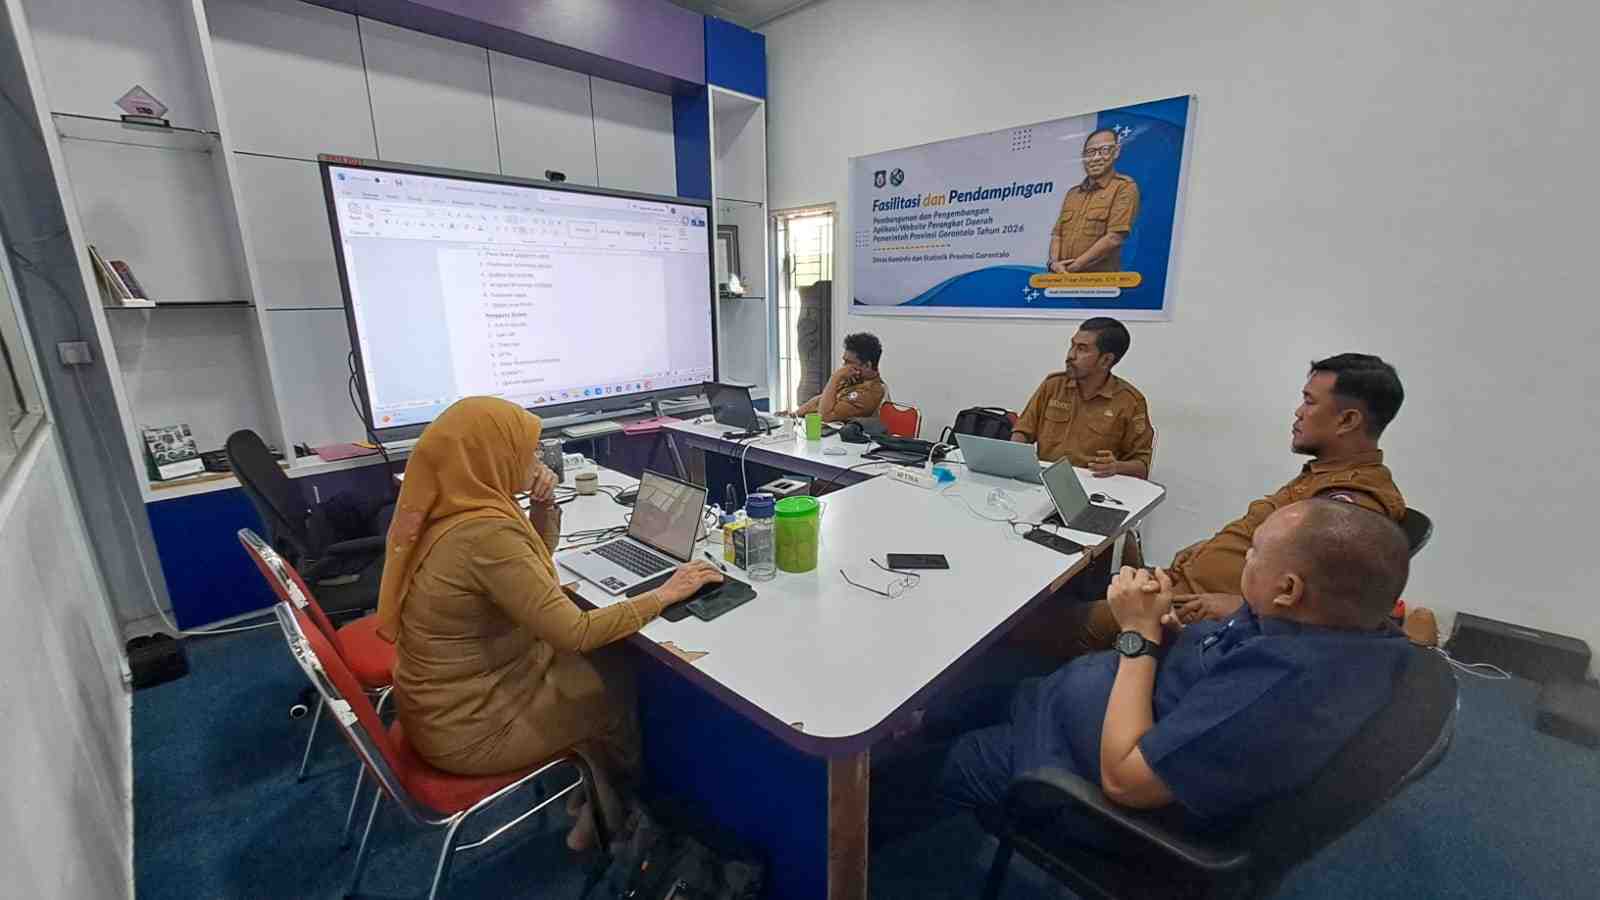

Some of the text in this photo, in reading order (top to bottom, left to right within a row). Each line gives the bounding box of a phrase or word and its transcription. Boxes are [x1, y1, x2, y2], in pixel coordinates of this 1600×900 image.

[873, 181, 1053, 212] Fasilitasi dan Pendampingan
[919, 211, 932, 220] dan
[933, 208, 990, 219] Pengembangan
[927, 218, 964, 229] Perangkat
[965, 216, 993, 226] Daerah
[976, 225, 1001, 236] Tahun
[1001, 223, 1025, 234] 2026
